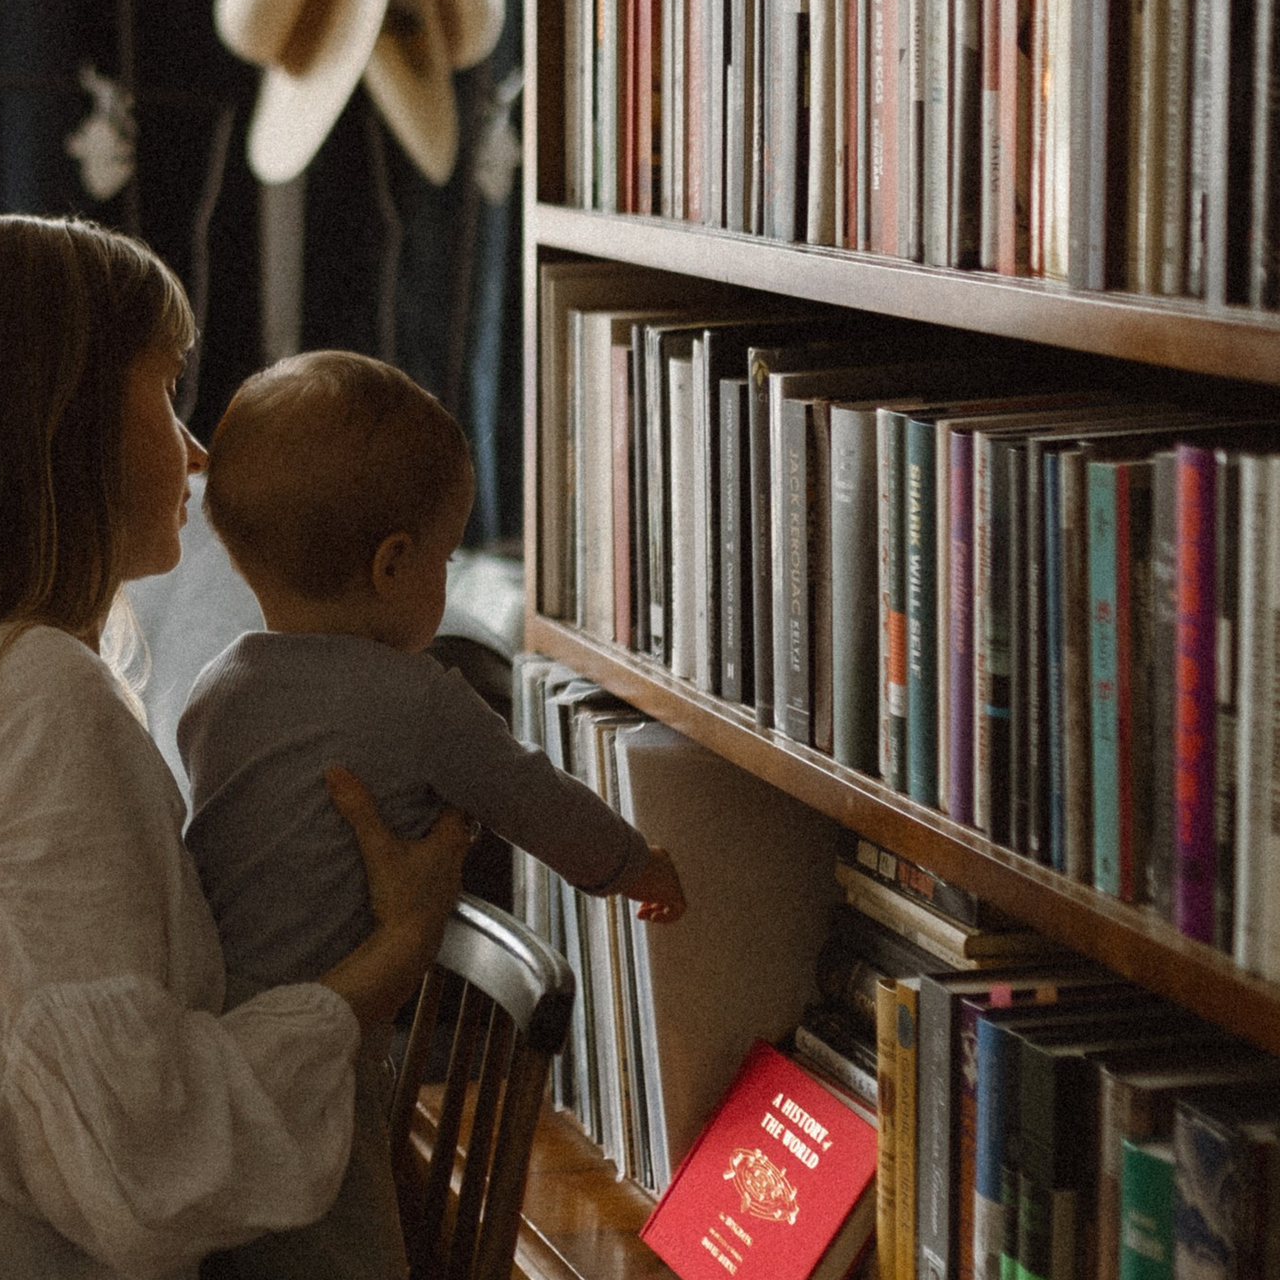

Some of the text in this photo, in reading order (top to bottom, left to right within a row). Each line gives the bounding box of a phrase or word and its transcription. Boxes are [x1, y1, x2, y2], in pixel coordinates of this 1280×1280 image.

[874, 10, 884, 50] AND
[874, 54, 884, 104] EGGS
[788, 448, 802, 505] JACK
[725, 397, 734, 649] HOW MUSIC WORKS DAVID BYRNE
[789, 512, 802, 617] KEROUAC
[909, 463, 922, 679] SHARK WILL SELF
[772, 1093, 783, 1109] A
[781, 1098, 829, 1142] HISTORY
[901, 1056, 910, 1143] GRAPHIC
[761, 1112, 820, 1170] THE WORLD
[901, 1150, 910, 1233] SCIENCE
